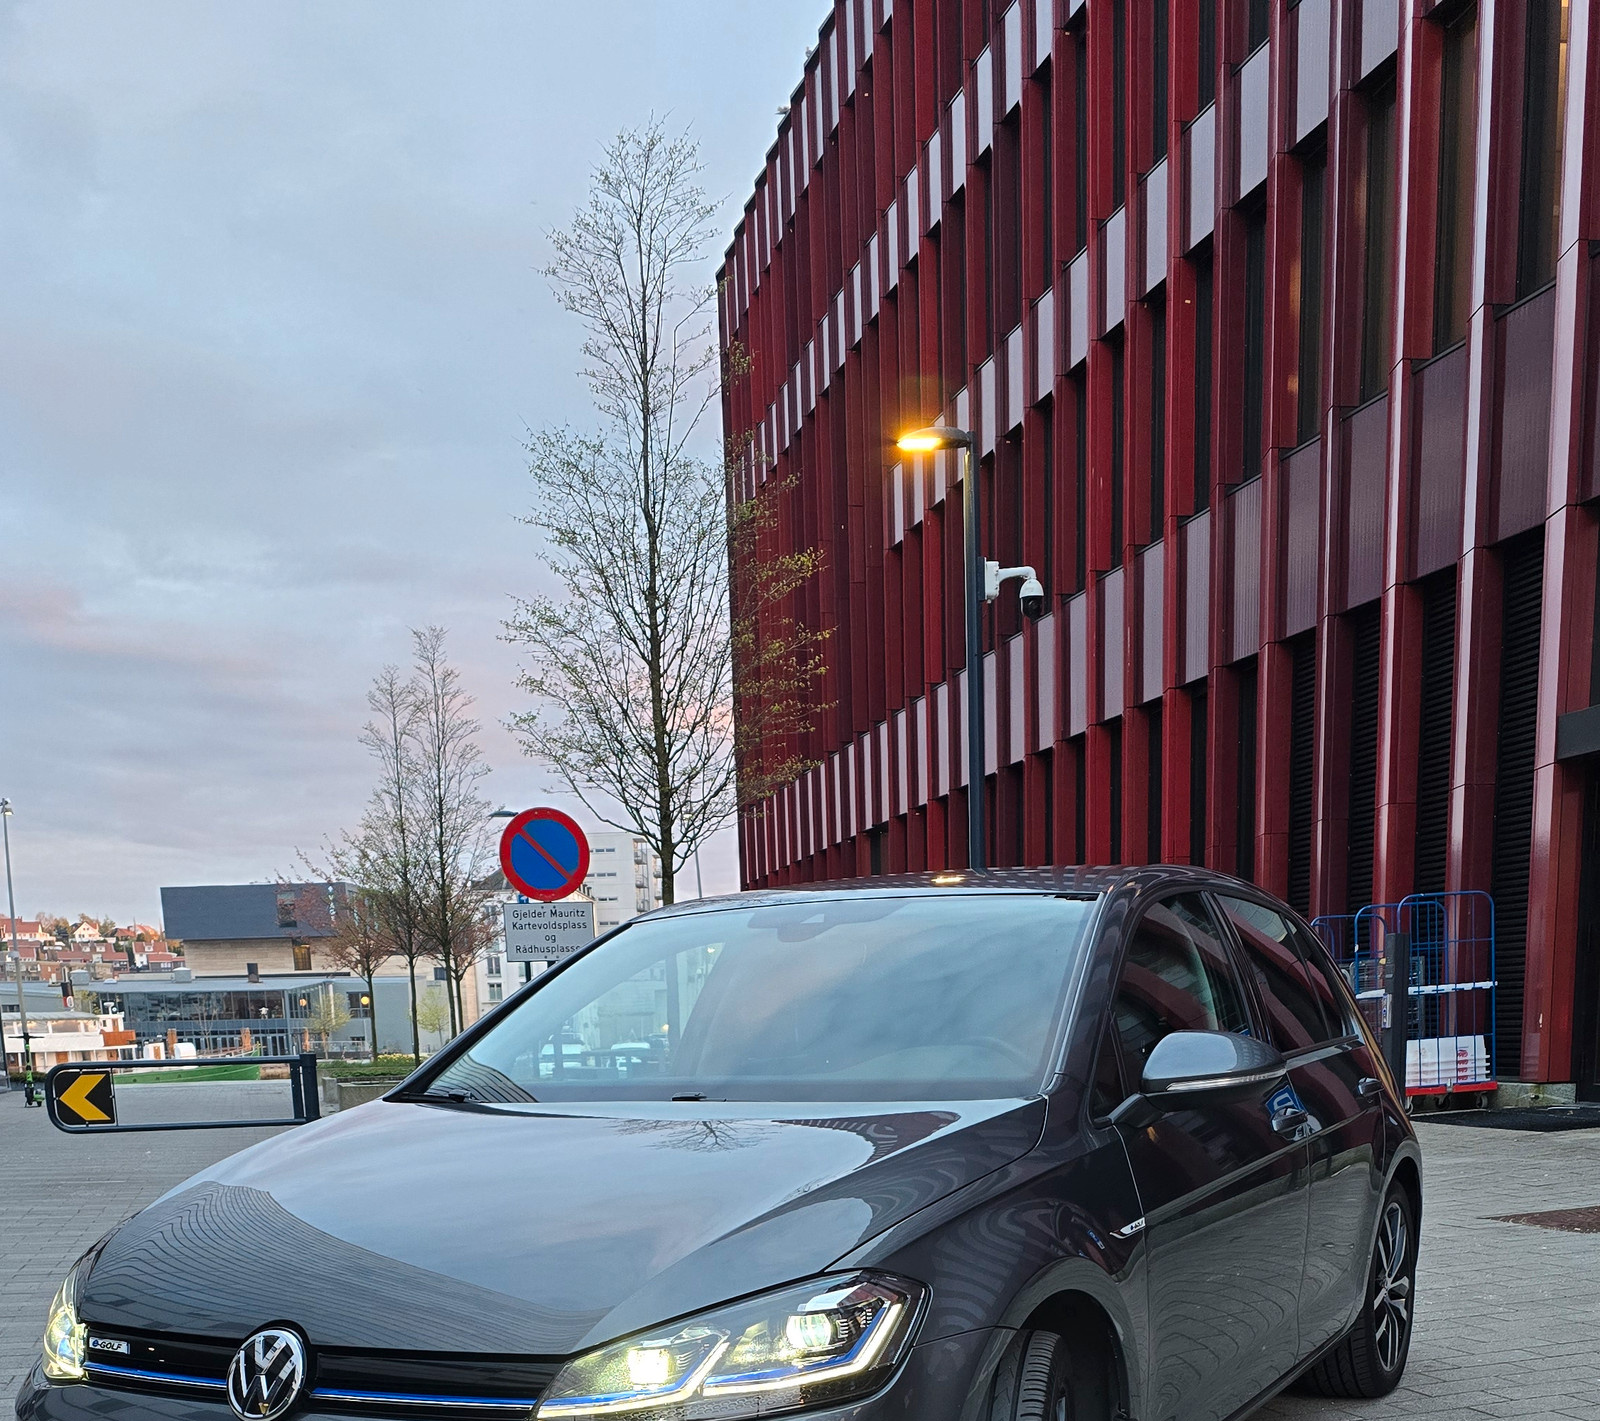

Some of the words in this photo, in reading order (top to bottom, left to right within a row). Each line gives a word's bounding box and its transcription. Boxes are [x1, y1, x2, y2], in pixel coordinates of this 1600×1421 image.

[512, 909, 547, 920] Gjelder
[550, 909, 585, 918] Mauritz
[512, 921, 588, 931] Kartevoldsplass
[544, 934, 557, 943] og
